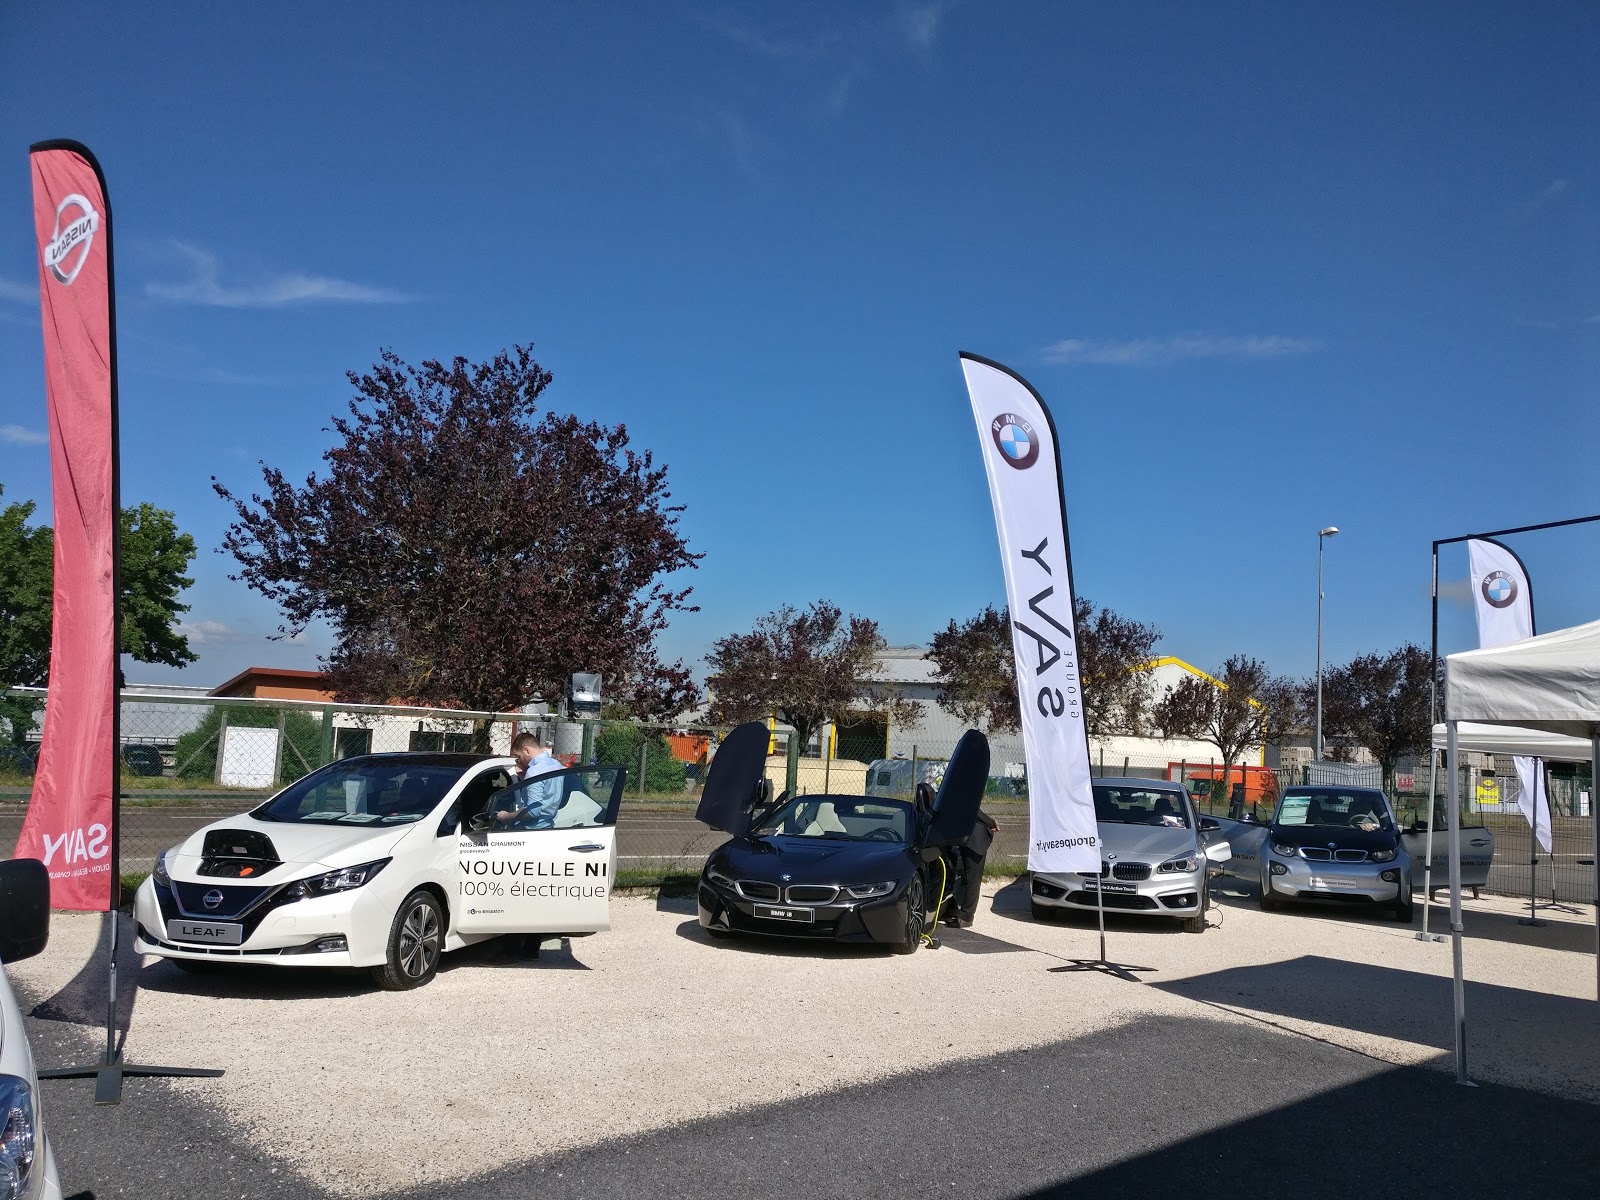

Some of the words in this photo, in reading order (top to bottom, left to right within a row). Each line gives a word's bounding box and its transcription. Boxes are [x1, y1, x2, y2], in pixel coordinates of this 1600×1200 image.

[459, 860, 575, 877] NOUVELLE
[585, 862, 607, 877] NI
[459, 881, 504, 897] 100%
[510, 880, 606, 901] électrique
[771, 909, 785, 917] BMW
[182, 925, 226, 937] LEAF
